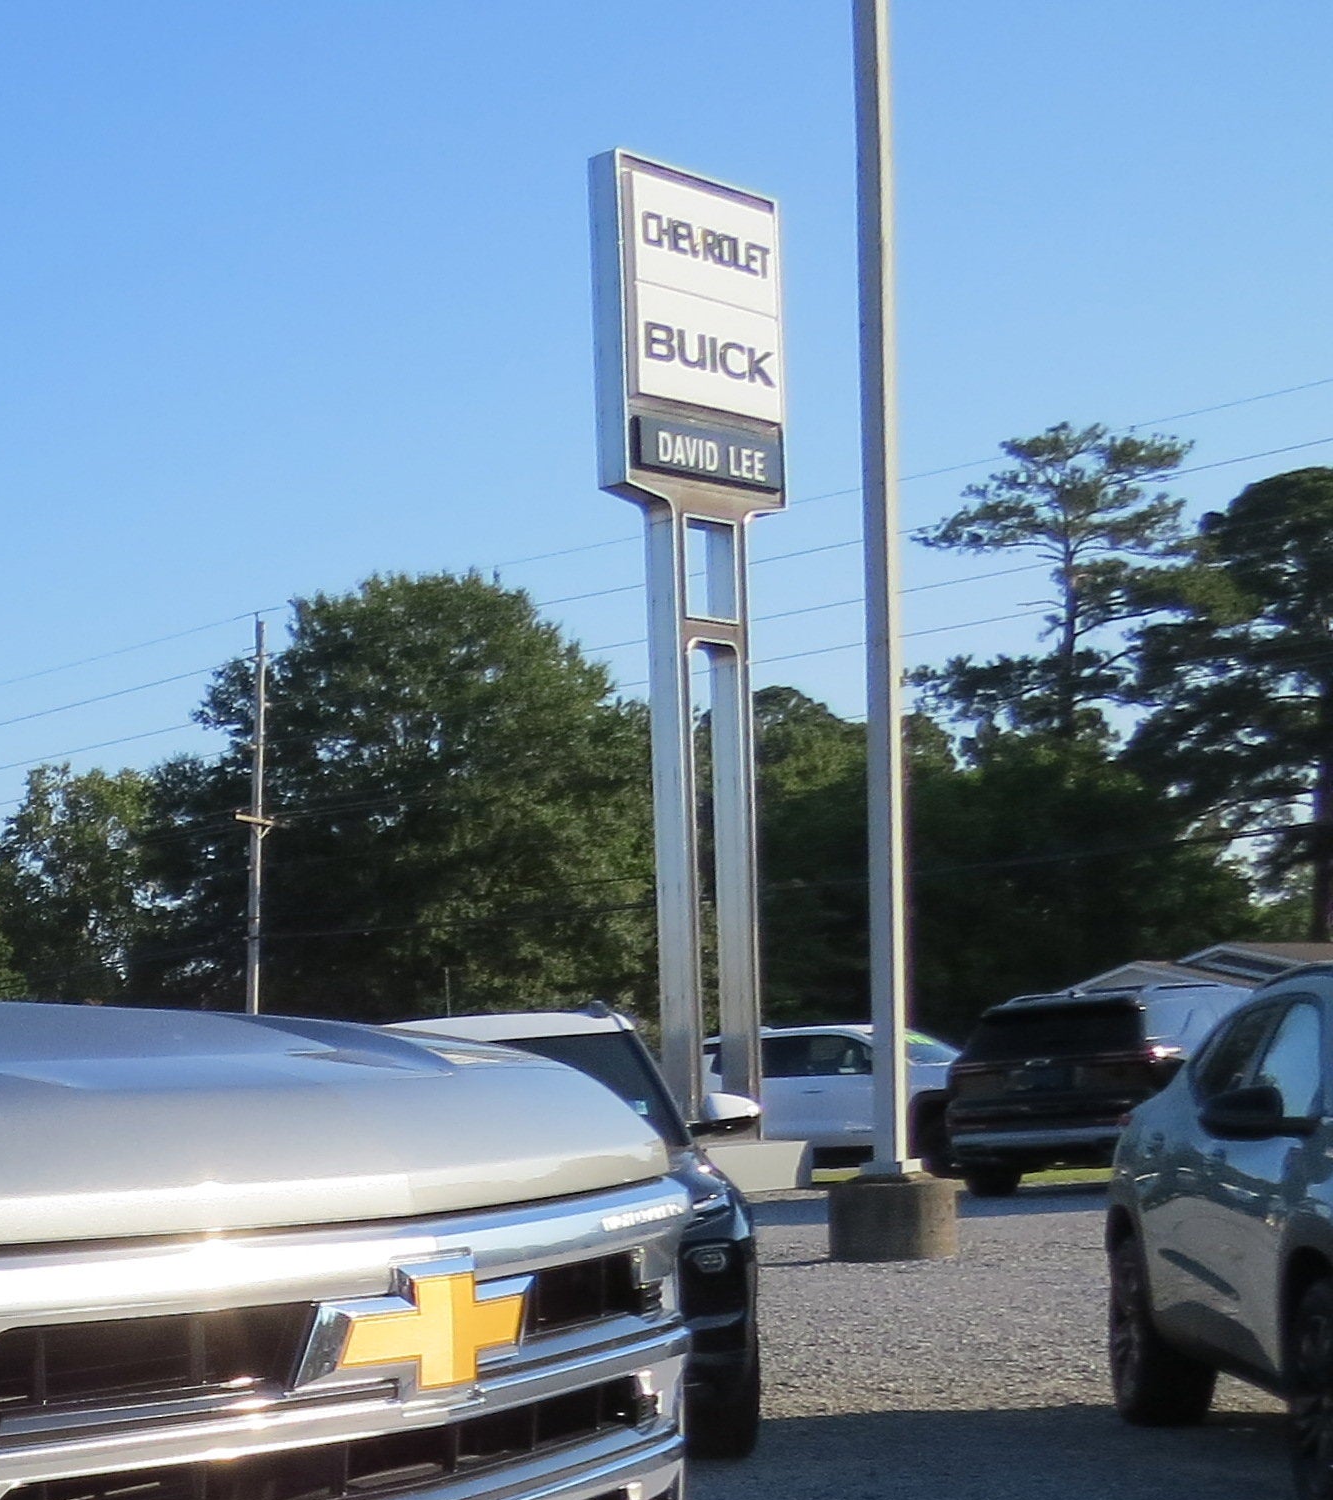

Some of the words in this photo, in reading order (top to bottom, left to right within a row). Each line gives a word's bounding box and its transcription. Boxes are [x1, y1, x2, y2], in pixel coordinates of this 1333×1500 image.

[642, 210, 770, 279] CHEVROLET
[644, 320, 776, 388] BUICK
[657, 430, 719, 472] DAVID
[728, 445, 767, 482] LEE
